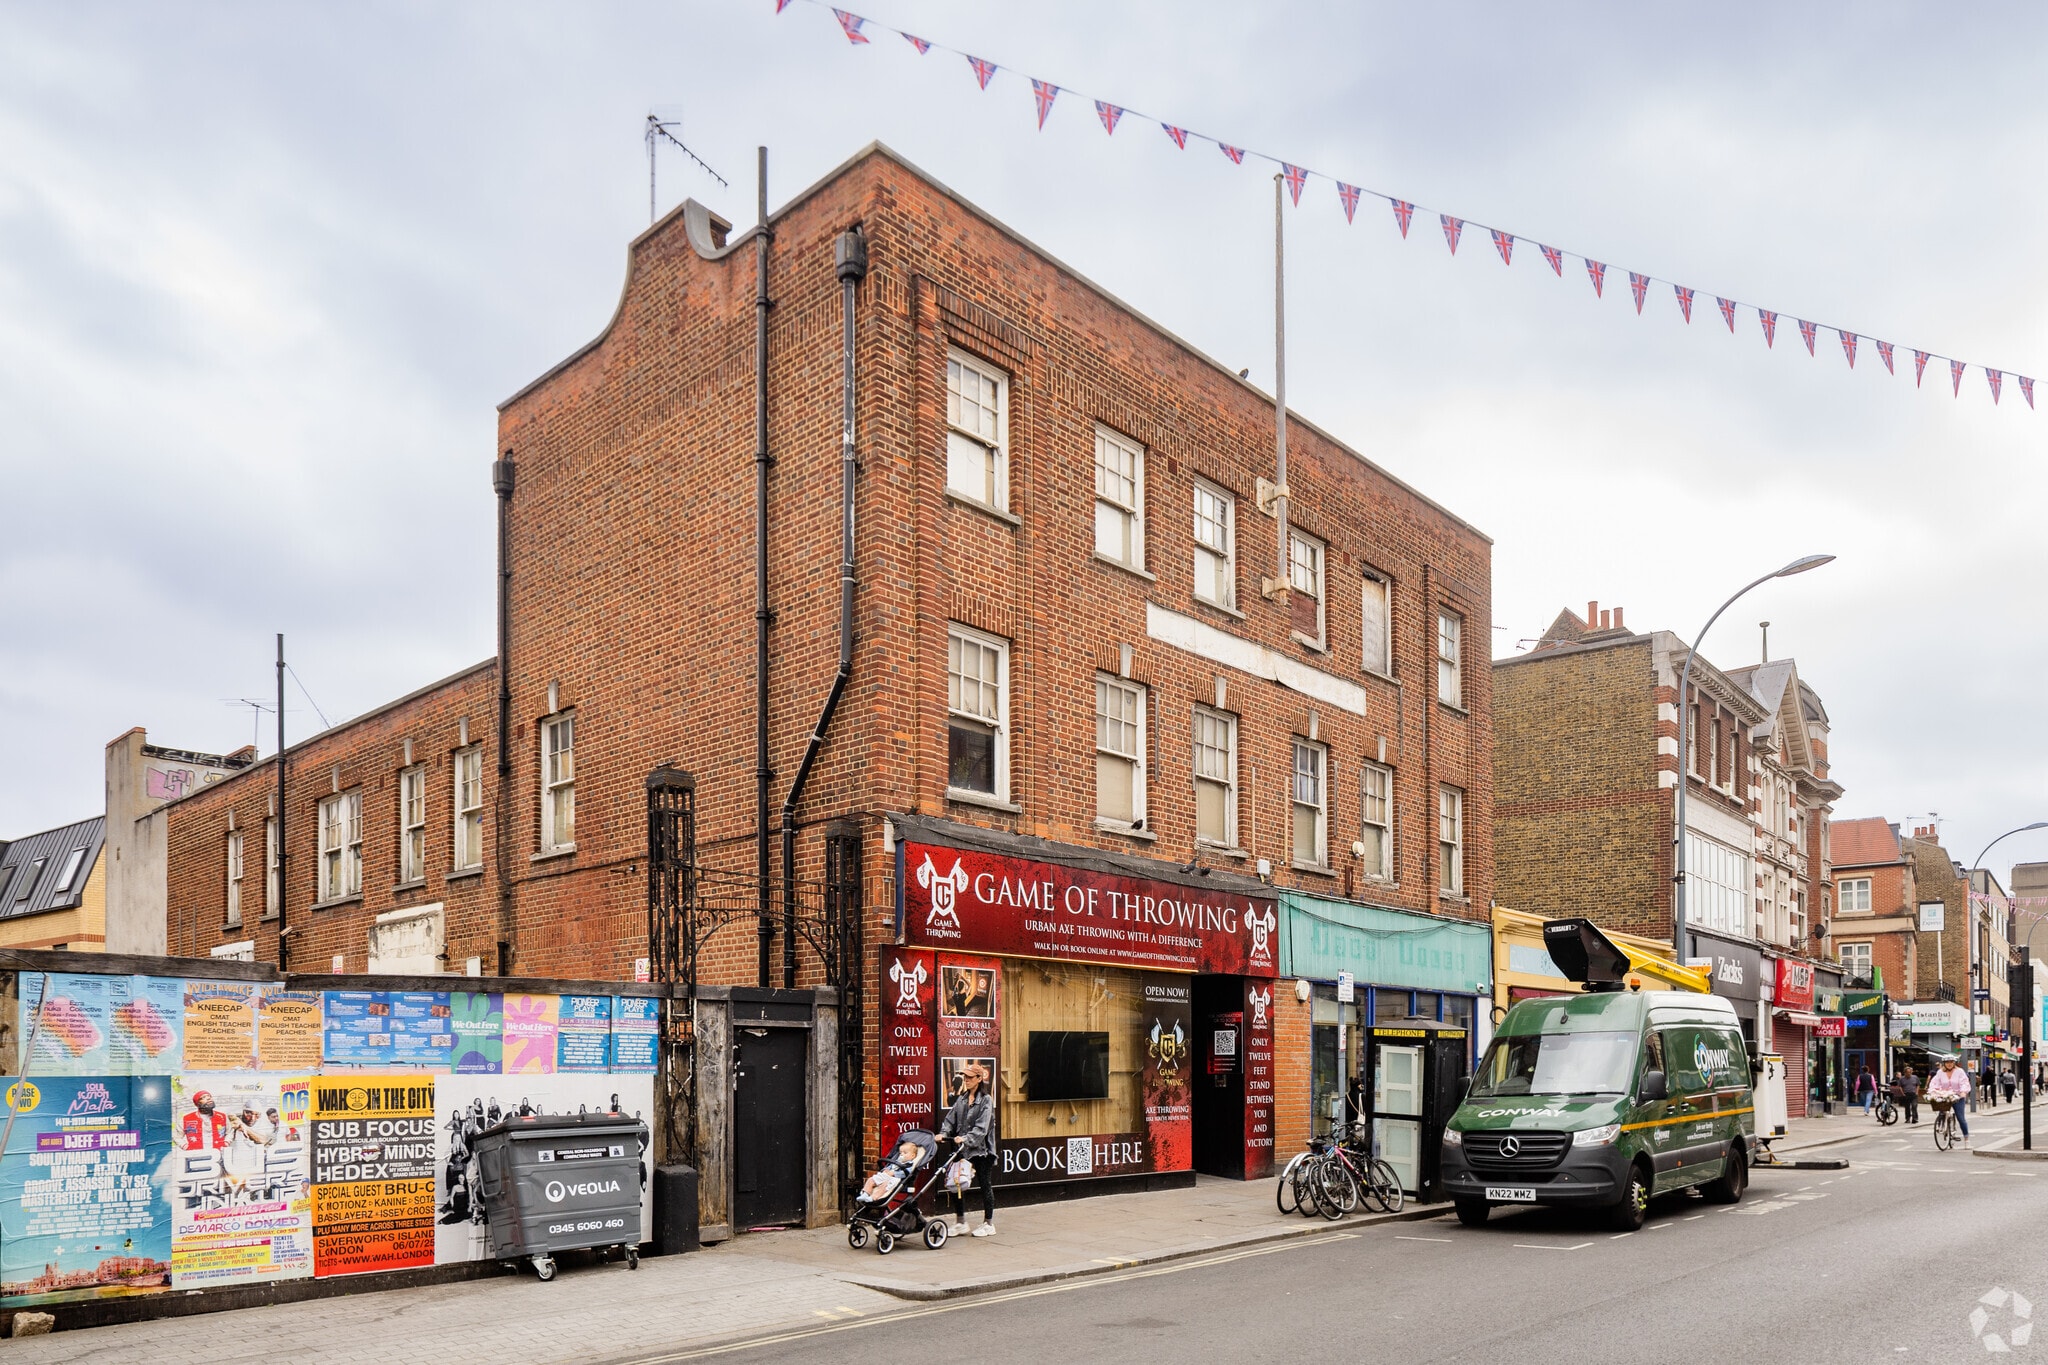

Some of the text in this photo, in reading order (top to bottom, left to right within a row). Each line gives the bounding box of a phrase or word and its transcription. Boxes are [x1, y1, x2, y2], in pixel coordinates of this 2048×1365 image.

[974, 872, 1238, 934] GAME OF THROWING
[934, 919, 953, 928] GAME
[925, 927, 962, 939] THROWING
[1025, 919, 1203, 950] URBAN AXE THROWING WITH A DIFFERENCE
[1034, 941, 1051, 951] WALK
[1052, 943, 1058, 952] IN
[1059, 944, 1069, 953] OR
[1069, 945, 1087, 955] BOOK
[1087, 946, 1106, 957] ONLINE
[1107, 948, 1116, 957] AT
[1250, 959, 1273, 968] THROWING
[1718, 956, 1743, 985] Zack's
[187, 982, 216, 996] WIDE
[218, 983, 254, 998] AWAKE
[1145, 986, 1165, 996] OPEN
[197, 1004, 243, 1012] KNEECAP
[1849, 995, 1881, 1012] SUBWAY
[270, 1006, 313, 1014] KNEECAP
[452, 1020, 481, 1030] We Out
[506, 1022, 519, 1031] We
[518, 1023, 535, 1031] Out
[946, 1021, 991, 1030] GREAT FOR ALL
[203, 1027, 236, 1035] PEACHES
[894, 1027, 924, 1038] ONLY
[950, 1029, 987, 1037] OCCASIONS
[1377, 1029, 1422, 1037] TELEPHONE
[948, 1038, 963, 1046] AND
[1252, 1037, 1268, 1046] ONLY
[889, 1046, 928, 1057] TWELVE
[1248, 1052, 1271, 1061] TWELVE
[1694, 1048, 1729, 1069] CONWAY
[897, 1065, 920, 1076] FEET
[1160, 1068, 1177, 1076] GAME
[1253, 1067, 1267, 1075] FEET
[281, 1081, 310, 1092] SUNDAY
[891, 1084, 926, 1095] STAND
[1249, 1080, 1270, 1090] STAND
[12, 1088, 35, 1097] PASE
[282, 1089, 309, 1112] 06
[318, 1086, 435, 1111] WAH IN THE CITY
[1246, 1095, 1273, 1104] BETWEEN
[67, 1099, 117, 1116] Malta
[885, 1102, 932, 1114] BETWEEN
[1145, 1105, 1189, 1114] AXE THROWING
[1478, 1107, 1567, 1118] CONWAY
[287, 1112, 304, 1121] JULY
[1253, 1110, 1267, 1119] YOU
[317, 1119, 435, 1139] SUB FOCUS
[897, 1122, 920, 1133] YOU
[1253, 1124, 1267, 1133] AND
[64, 1134, 94, 1148] DJEFF
[1247, 1137, 1273, 1148] VICTORY
[384, 1143, 435, 1160] MINDS
[1003, 1141, 1143, 1173] BOOK HERE
[29, 1151, 101, 1166] SOULDYNAMIC
[179, 1148, 303, 1180] BUS
[51, 1165, 87, 1179] MANOO
[317, 1163, 389, 1183] HEDEX
[24, 1179, 64, 1194] GROOVE
[66, 1176, 114, 1191] ASSASSIN
[120, 1176, 133, 1188] SY
[317, 1181, 435, 1200] SPECIAL GUEST BRU-C
[567, 1180, 621, 1197] VEOLIA
[21, 1187, 152, 1207] MASTERSTEPZ MATT WHITE
[1489, 1189, 1532, 1199] KN22 WMZ
[317, 1202, 324, 1211] K
[374, 1197, 407, 1207] KANINE
[414, 1195, 435, 1205] SOTA
[317, 1205, 435, 1223] BASSLAYERZ ISSEY CROSS
[179, 1222, 241, 1235] DEMARCO
[331, 1224, 349, 1234] MANY
[350, 1223, 369, 1232] MORE
[370, 1221, 394, 1231] ACROSS
[395, 1220, 413, 1229] THREE
[549, 1218, 624, 1234] 0345 6060 460
[181, 1234, 216, 1242] ADDINGTON
[318, 1229, 435, 1248] SLVERWORKS ISLAND
[393, 1239, 435, 1251] 06/07/25
[342, 1250, 435, 1265] WWW.WAH.LONDON
